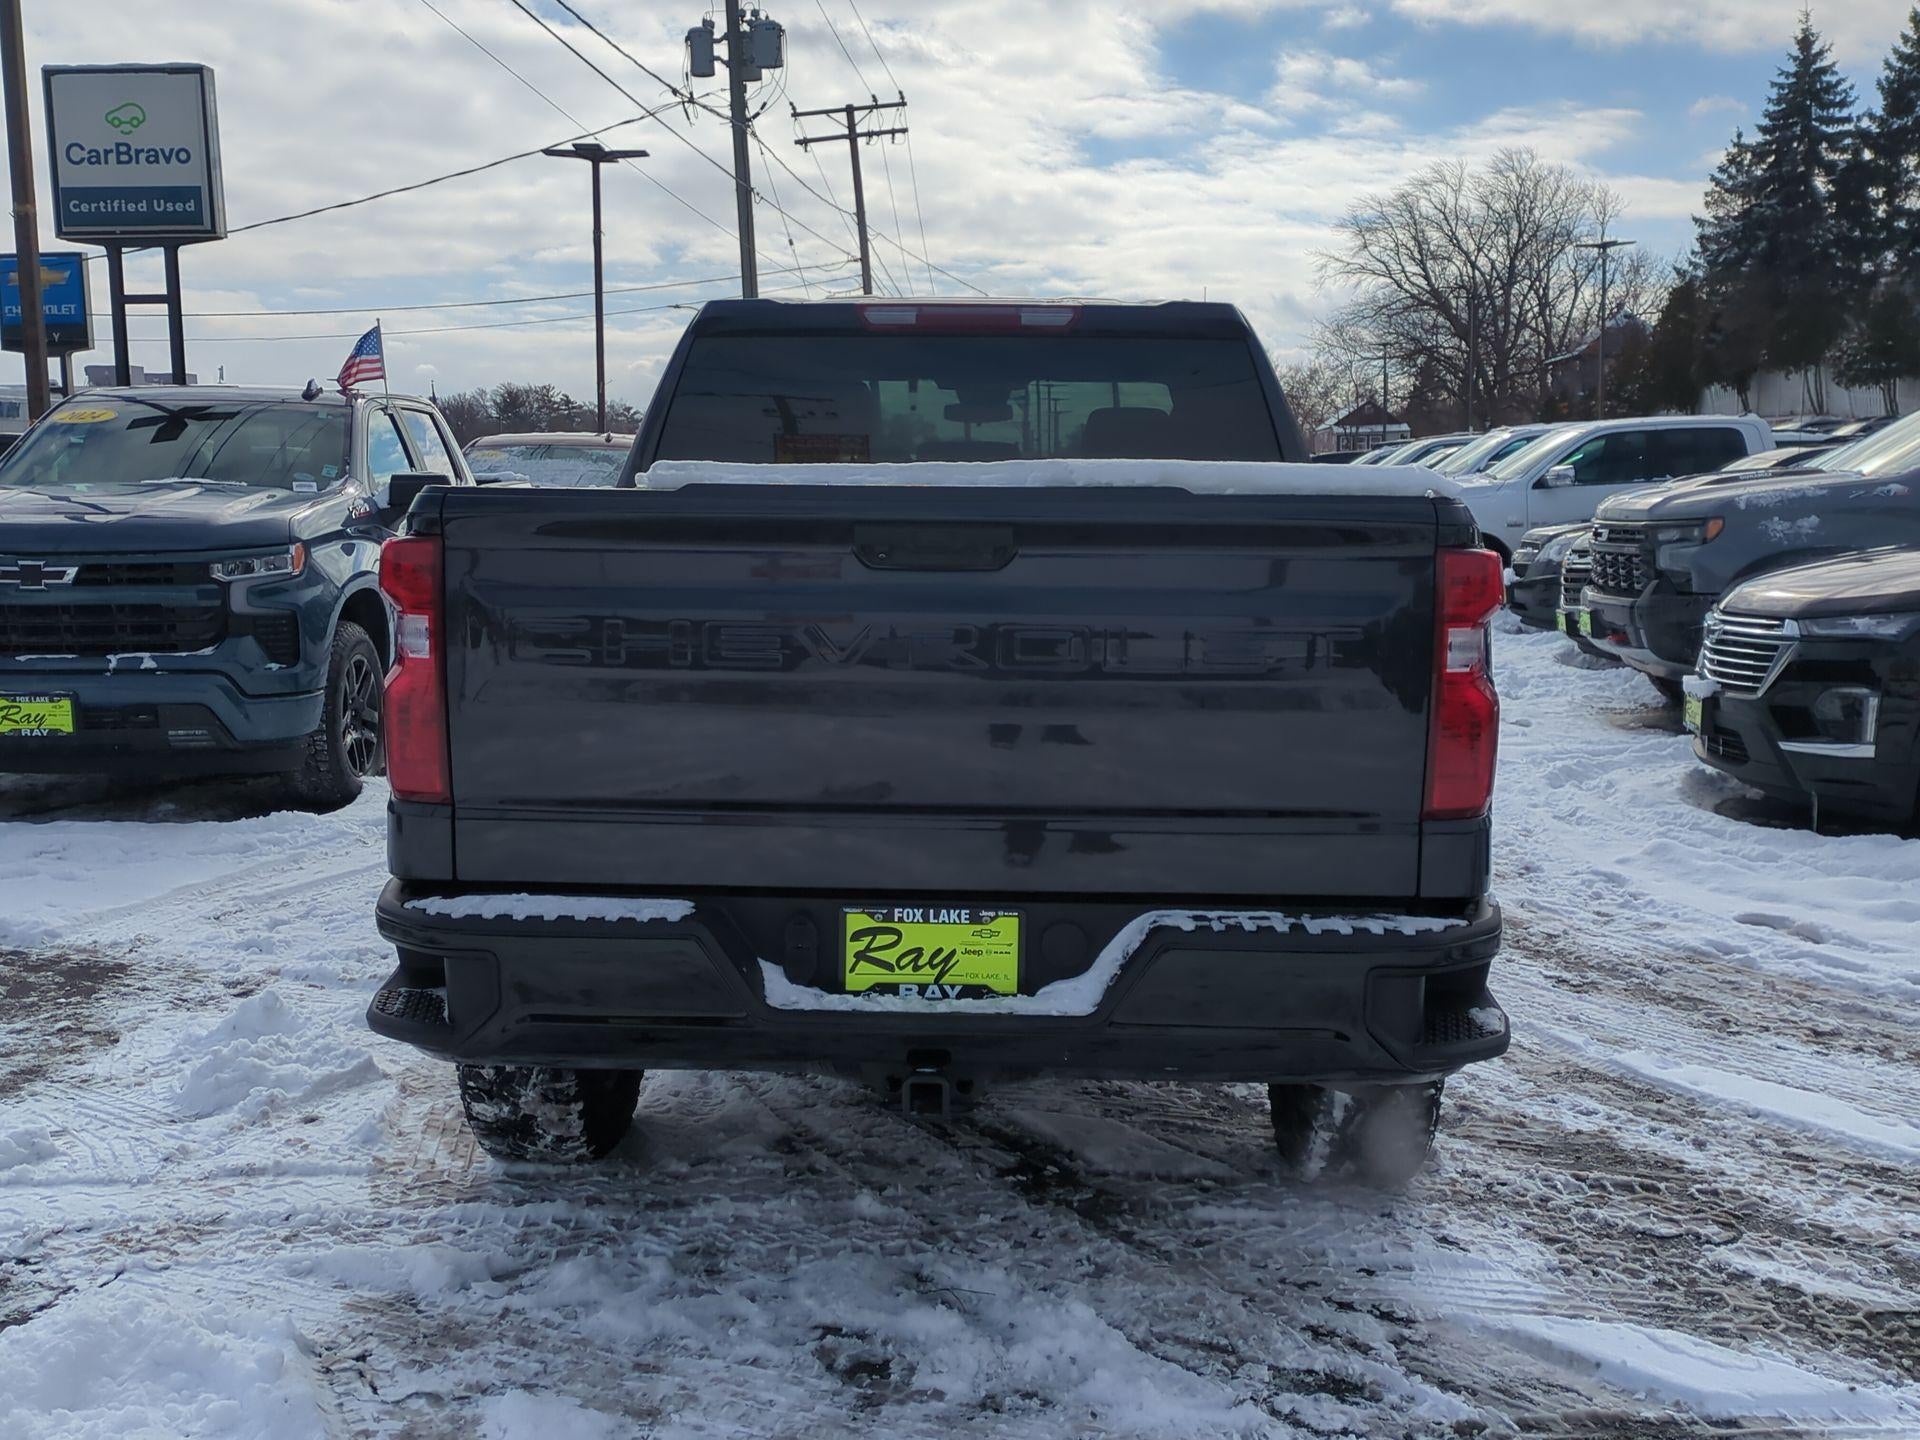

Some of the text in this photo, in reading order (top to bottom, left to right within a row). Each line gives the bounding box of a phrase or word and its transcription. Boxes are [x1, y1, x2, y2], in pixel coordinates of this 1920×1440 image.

[65, 142, 191, 165] CarBravo
[69, 199, 196, 213] Certified Used
[4, 304, 77, 316] CHOLET
[0, 704, 47, 729] Ray
[21, 728, 49, 736] RAY
[894, 908, 970, 924] FOX LAKE
[849, 926, 960, 984] Ray
[961, 947, 983, 957] Jeep
